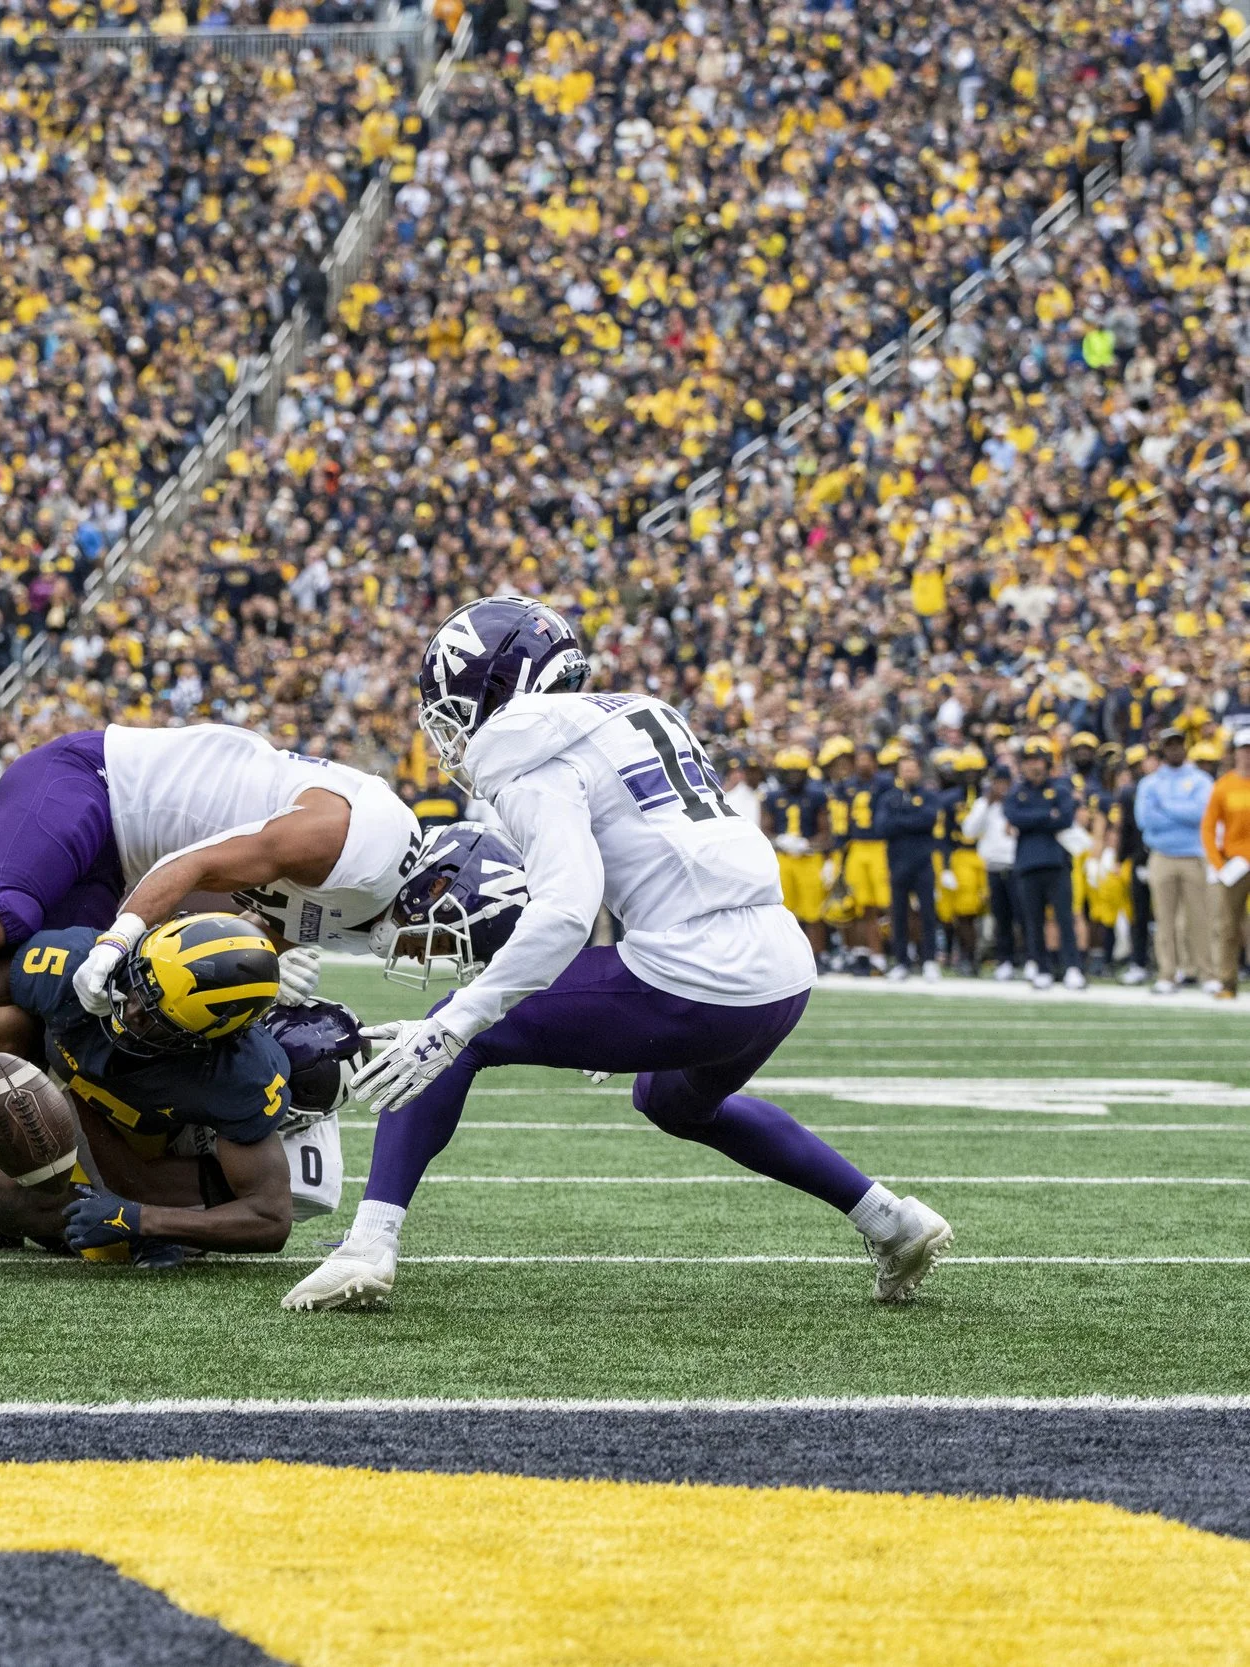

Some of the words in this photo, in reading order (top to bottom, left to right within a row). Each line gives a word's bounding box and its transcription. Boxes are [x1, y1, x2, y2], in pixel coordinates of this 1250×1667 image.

[625, 708, 741, 823] 11
[23, 947, 68, 976] 5
[263, 1073, 287, 1117] 5
